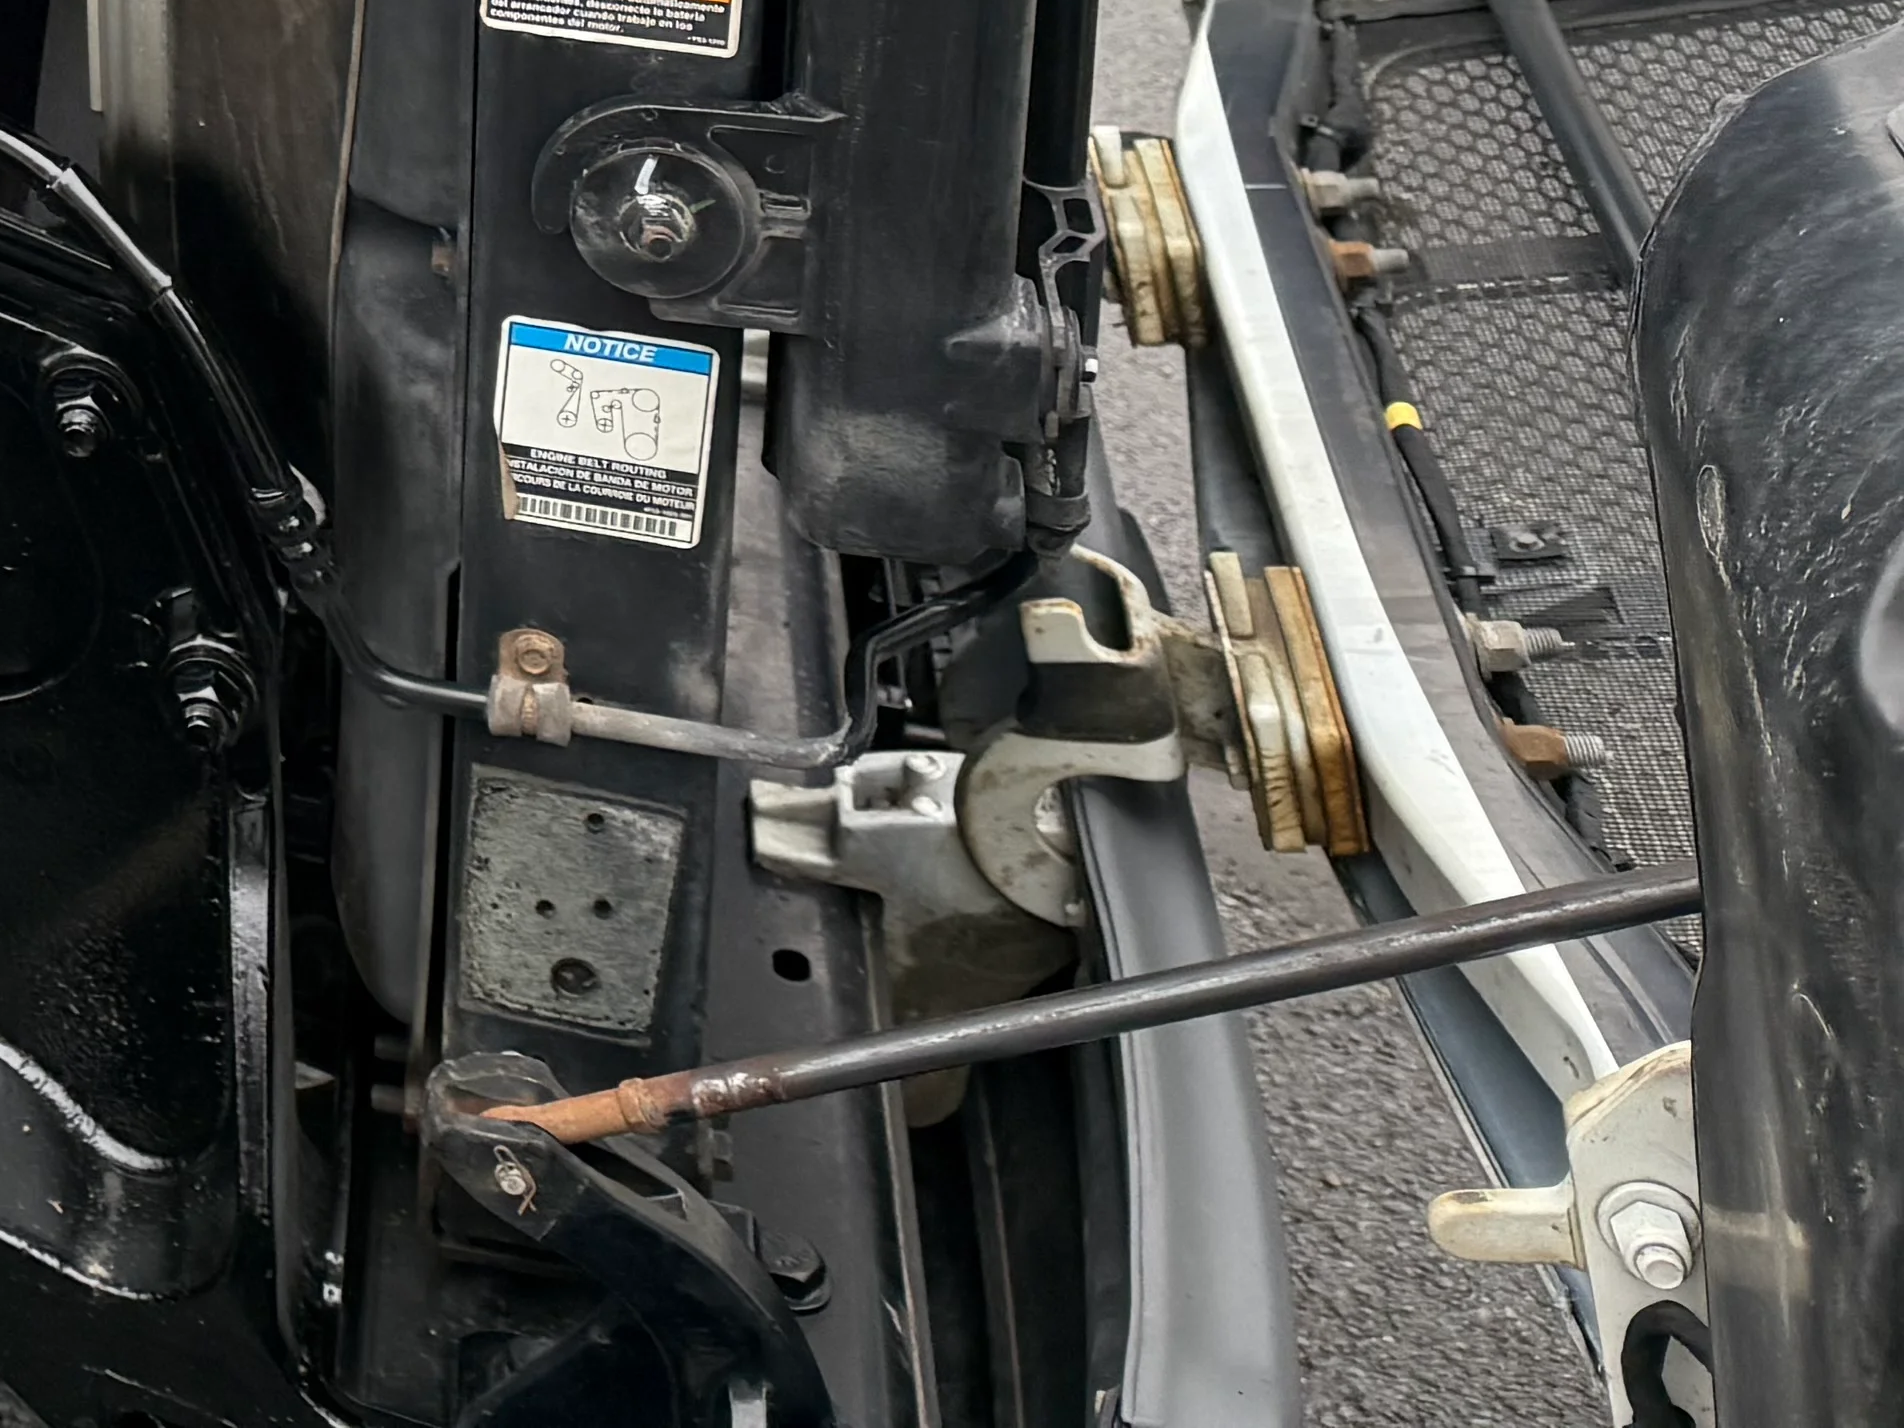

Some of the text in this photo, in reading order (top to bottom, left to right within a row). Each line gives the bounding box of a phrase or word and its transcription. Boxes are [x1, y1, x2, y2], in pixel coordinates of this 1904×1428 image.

[564, 333, 657, 362] NOTICE
[530, 450, 667, 479] ENGINE BELT ROUTING
[576, 470, 590, 481] DE
[593, 473, 631, 487] BANDA
[634, 479, 649, 490] DE
[652, 482, 693, 497] MOTOR
